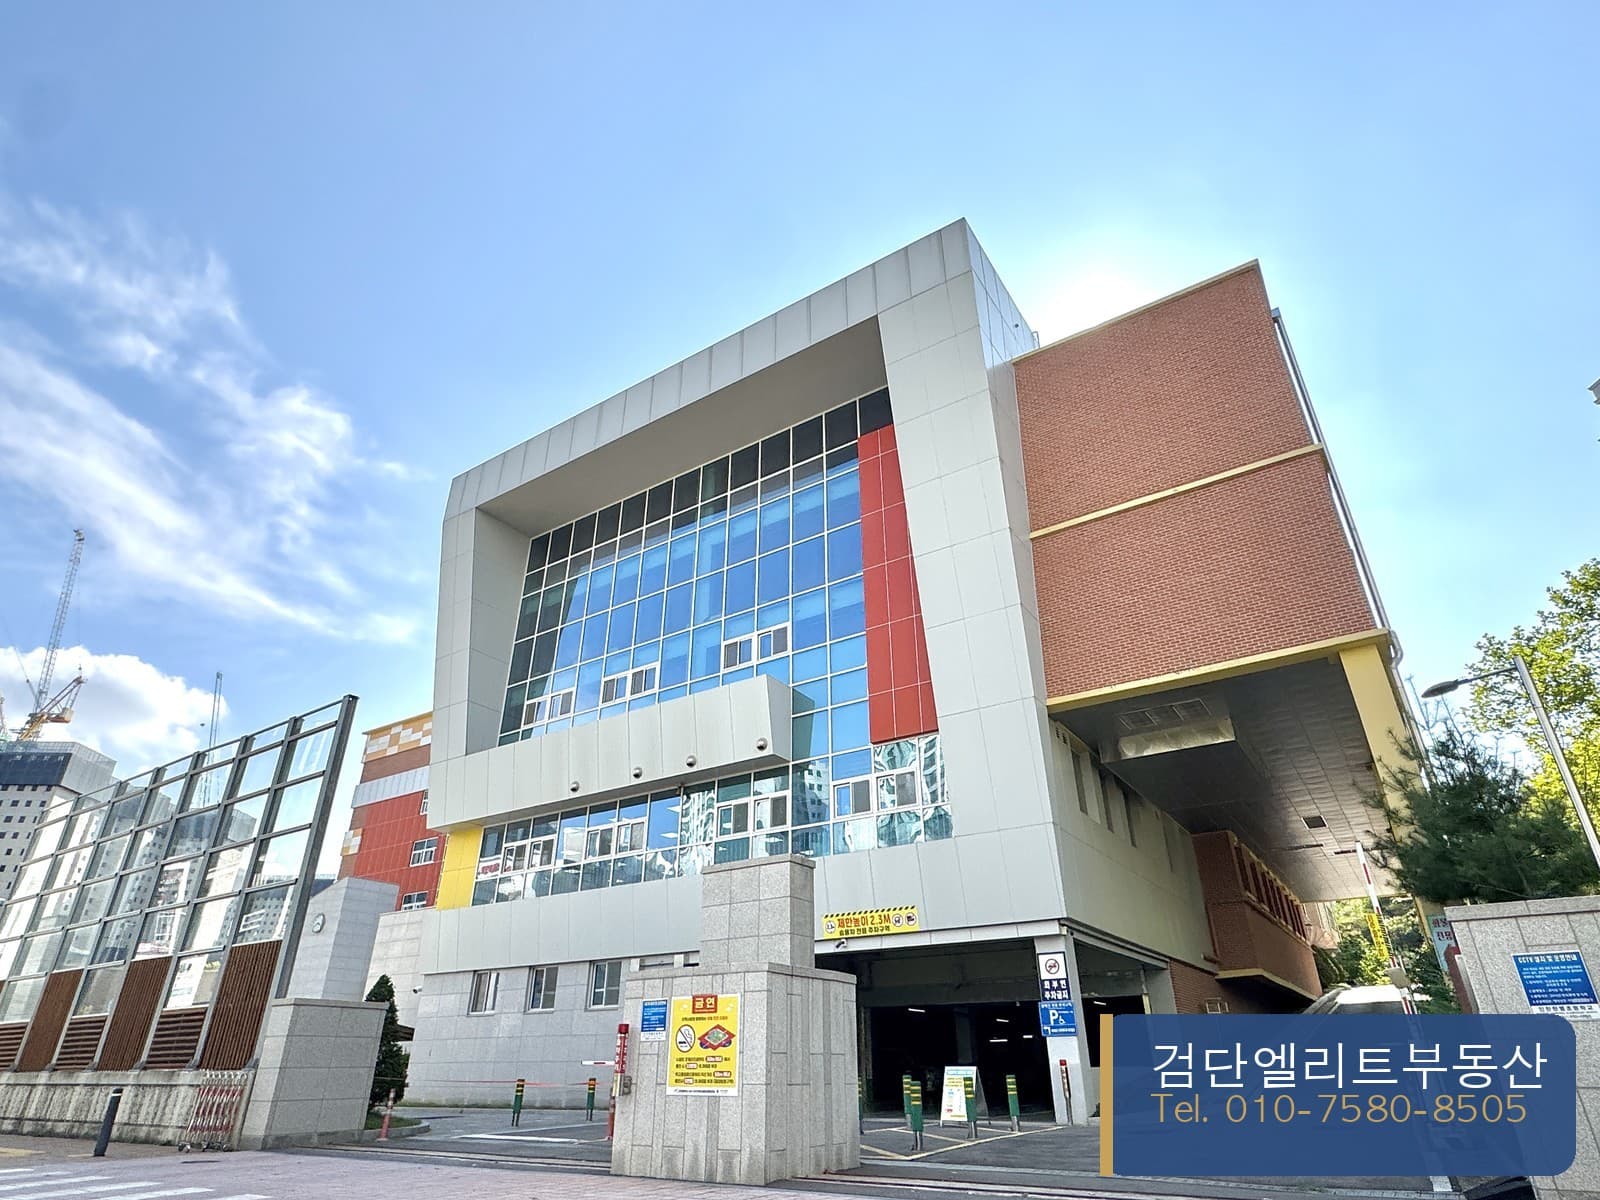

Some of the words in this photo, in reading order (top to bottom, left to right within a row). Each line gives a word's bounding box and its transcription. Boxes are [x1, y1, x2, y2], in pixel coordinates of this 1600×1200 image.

[870, 913, 891, 926] 2.3M
[695, 997, 715, 1009] 금연
[1049, 1009, 1059, 1026] P
